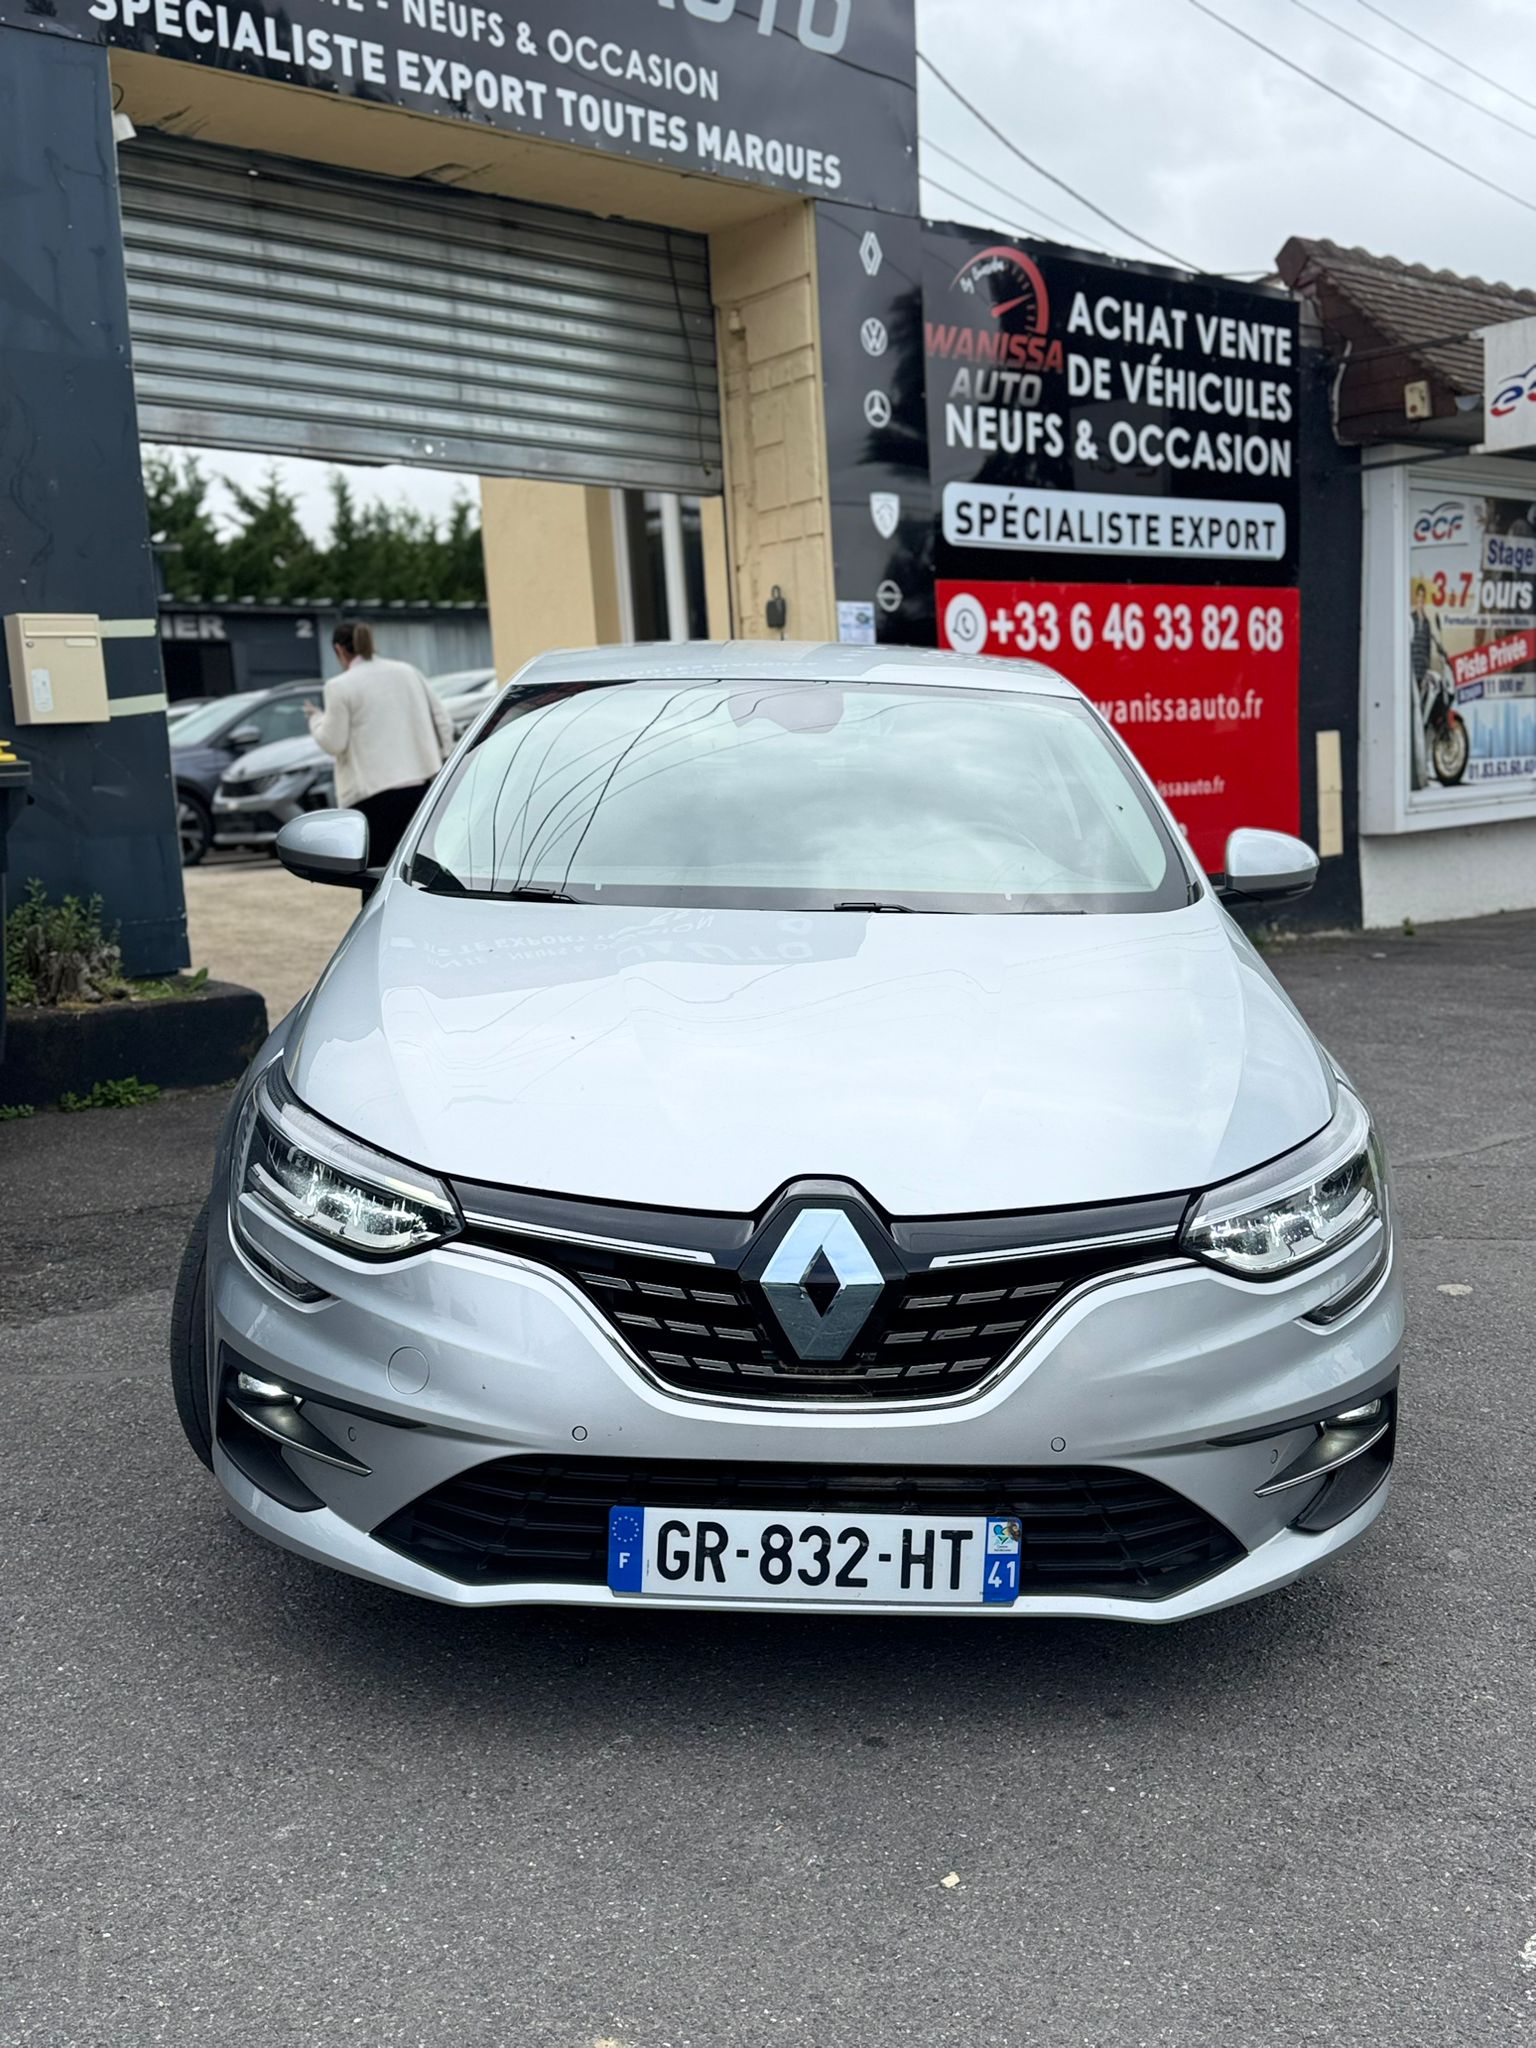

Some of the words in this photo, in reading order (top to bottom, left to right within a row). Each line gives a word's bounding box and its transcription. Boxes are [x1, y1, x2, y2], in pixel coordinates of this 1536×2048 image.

[403, 0, 505, 48] NEUFS
[517, 21, 538, 56] &
[547, 29, 719, 101] OCCASION
[396, 49, 547, 120] EXPORT
[556, 87, 688, 153] TOUTES
[697, 121, 841, 189] MARQUES
[925, 321, 1064, 373] WANISSA
[1067, 292, 1187, 350] ACHAT
[1196, 313, 1292, 366] VENTE
[949, 367, 1042, 407] AUTO
[1068, 354, 1111, 400] DE
[1120, 354, 1292, 423] VÉHICULES
[945, 403, 1063, 458] NEUFS
[1075, 419, 1099, 461] &
[1109, 421, 1292, 478] OCCASION
[955, 492, 1160, 547] SPÉCIALISTE
[1171, 515, 1276, 551] EXPORT
[1488, 538, 1534, 573] Stage
[1432, 571, 1447, 608] 3
[1459, 571, 1473, 608] 7
[1472, 573, 1533, 613] jours
[990, 601, 1060, 651] +33
[1070, 602, 1093, 651] 6
[1102, 603, 1145, 651] 46
[1154, 604, 1192, 651] 33
[1202, 605, 1239, 651] 82
[1248, 606, 1283, 652] 68
[1456, 651, 1488, 683] Piste
[619, 1552, 630, 1568] F
[657, 1519, 973, 1590] GR-832-HT
[988, 1561, 1015, 1588] 41
